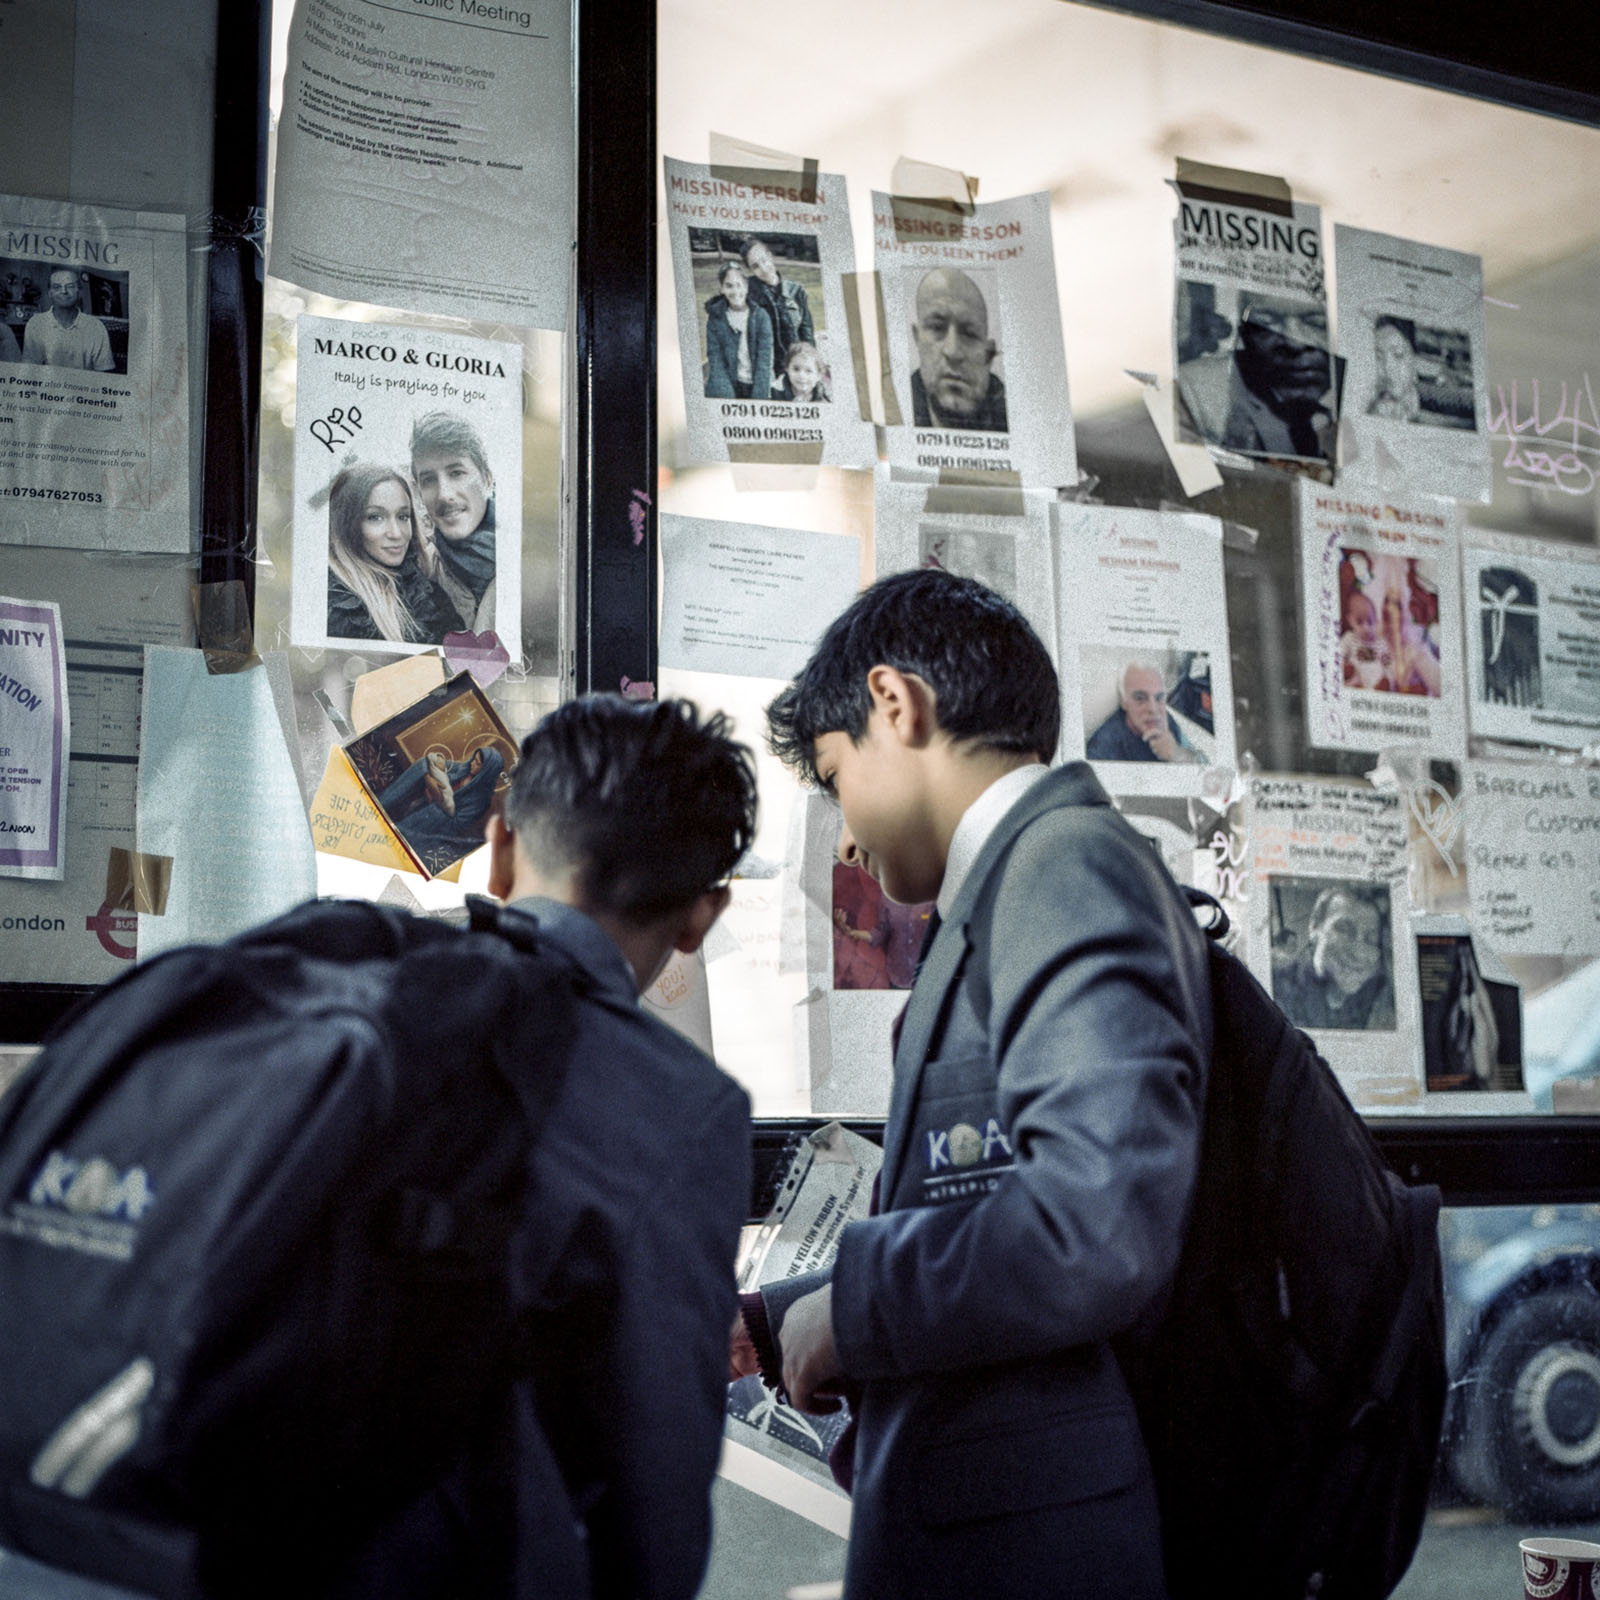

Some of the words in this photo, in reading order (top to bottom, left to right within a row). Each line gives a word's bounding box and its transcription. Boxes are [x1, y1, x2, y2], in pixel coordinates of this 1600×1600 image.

[460, 0, 531, 28] Meeting
[404, 68, 440, 82] London
[671, 175, 746, 200] MISSING
[751, 185, 826, 205] PERSON
[672, 201, 706, 217] HAVE
[711, 206, 739, 220] YOU
[743, 209, 781, 221] SEEN
[874, 213, 945, 237] MISSING
[949, 221, 1021, 240] PERSON
[1181, 202, 1319, 259] MISSING
[7, 231, 119, 265] MISSING
[314, 338, 397, 363] MARCO
[402, 348, 419, 365] &
[426, 351, 506, 379] GLORIA
[9, 377, 43, 387] Power
[45, 380, 62, 388] also
[63, 381, 89, 392] known
[101, 387, 132, 397] Steve
[334, 371, 366, 390] Italy
[370, 375, 382, 387] is
[386, 378, 439, 396] praying
[442, 382, 460, 397] for
[463, 390, 486, 404] you
[2, 390, 16, 398] the
[18, 390, 38, 399] 15th
[40, 393, 65, 402] floor
[76, 396, 117, 409] Grenfell
[37, 406, 52, 415] last
[54, 409, 81, 420] spoken
[93, 413, 122, 422] around
[723, 426, 761, 440] 0800
[8, 450, 24, 459] and
[41, 454, 69, 464] urging
[70, 456, 99, 467] anyone
[100, 459, 119, 468] with
[120, 461, 136, 469] any
[28, 440, 77, 453] increasingly
[78, 447, 119, 457] concerned
[120, 449, 133, 459] for
[135, 450, 146, 458] his
[12, 486, 103, 503] 07947627053
[0, 914, 65, 931] ondon
[786, 1261, 800, 1279] THE
[794, 1229, 819, 1262] YELLOW
[813, 1193, 839, 1229] RIBBON
